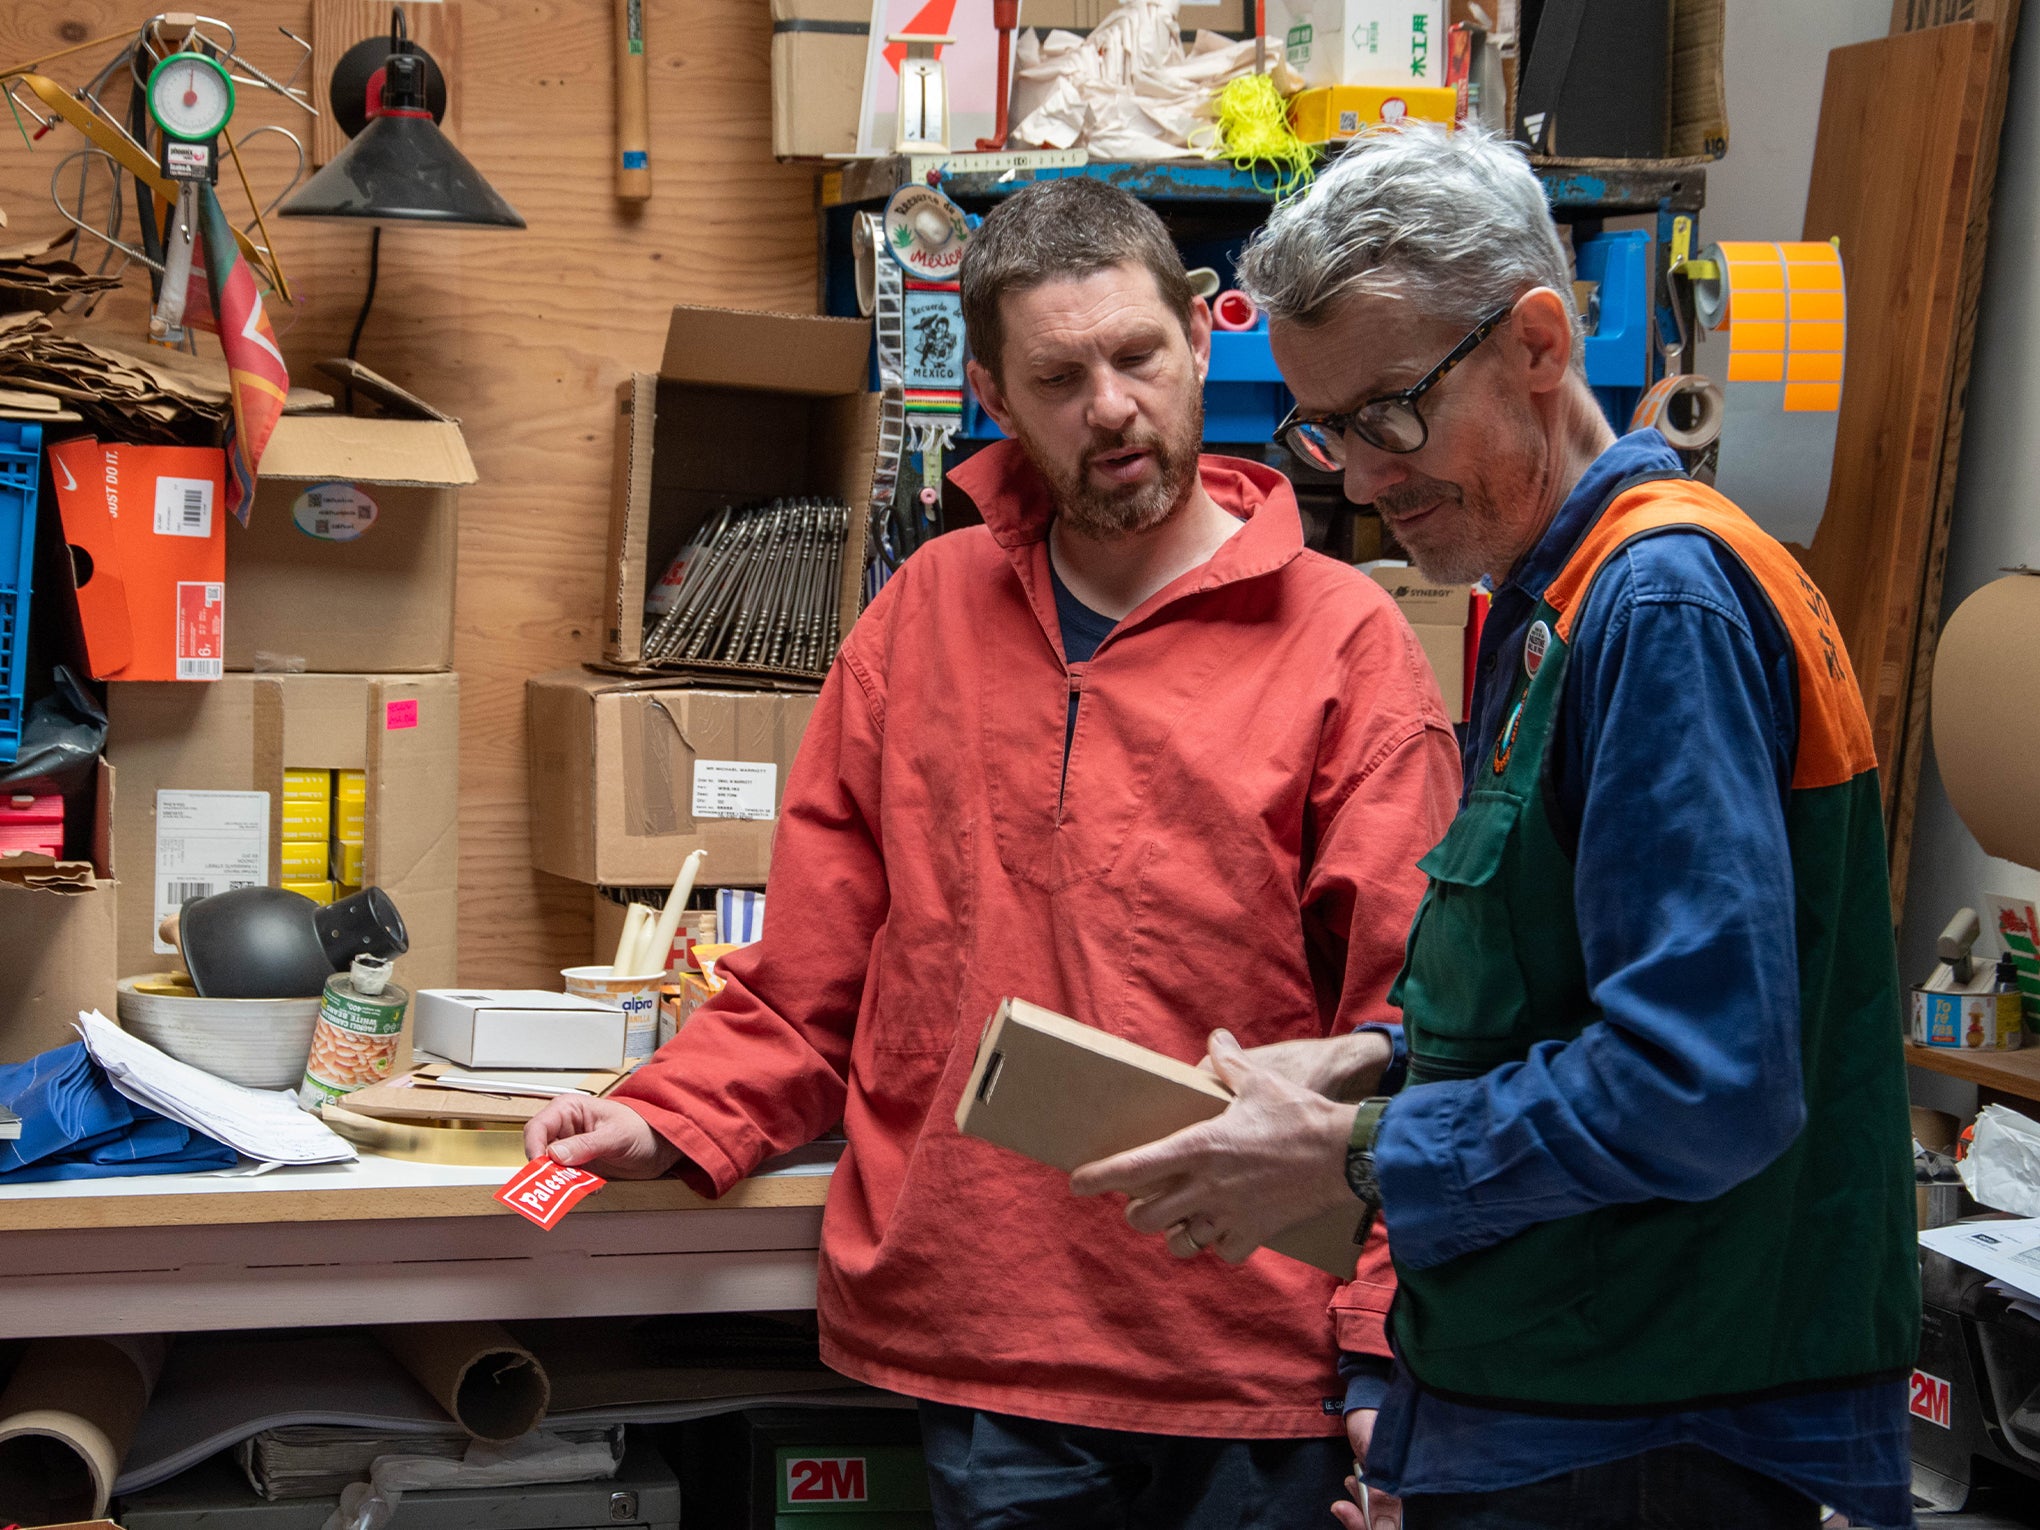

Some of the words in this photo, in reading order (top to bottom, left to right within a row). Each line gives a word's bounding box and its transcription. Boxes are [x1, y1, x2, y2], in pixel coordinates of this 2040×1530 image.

[910, 302, 948, 316] Recuerdo
[913, 368, 955, 378] MEXICO
[105, 466, 119, 486] DO
[106, 487, 119, 519] JUST
[1411, 588, 1451, 598] SYNERGY
[326, 1005, 348, 1019] BEANS
[622, 997, 652, 1014] alpro
[350, 1015, 377, 1025] WHITE
[518, 1167, 582, 1212] Palestine
[1911, 1372, 1949, 1426] 2M
[791, 1460, 865, 1500] 2M
